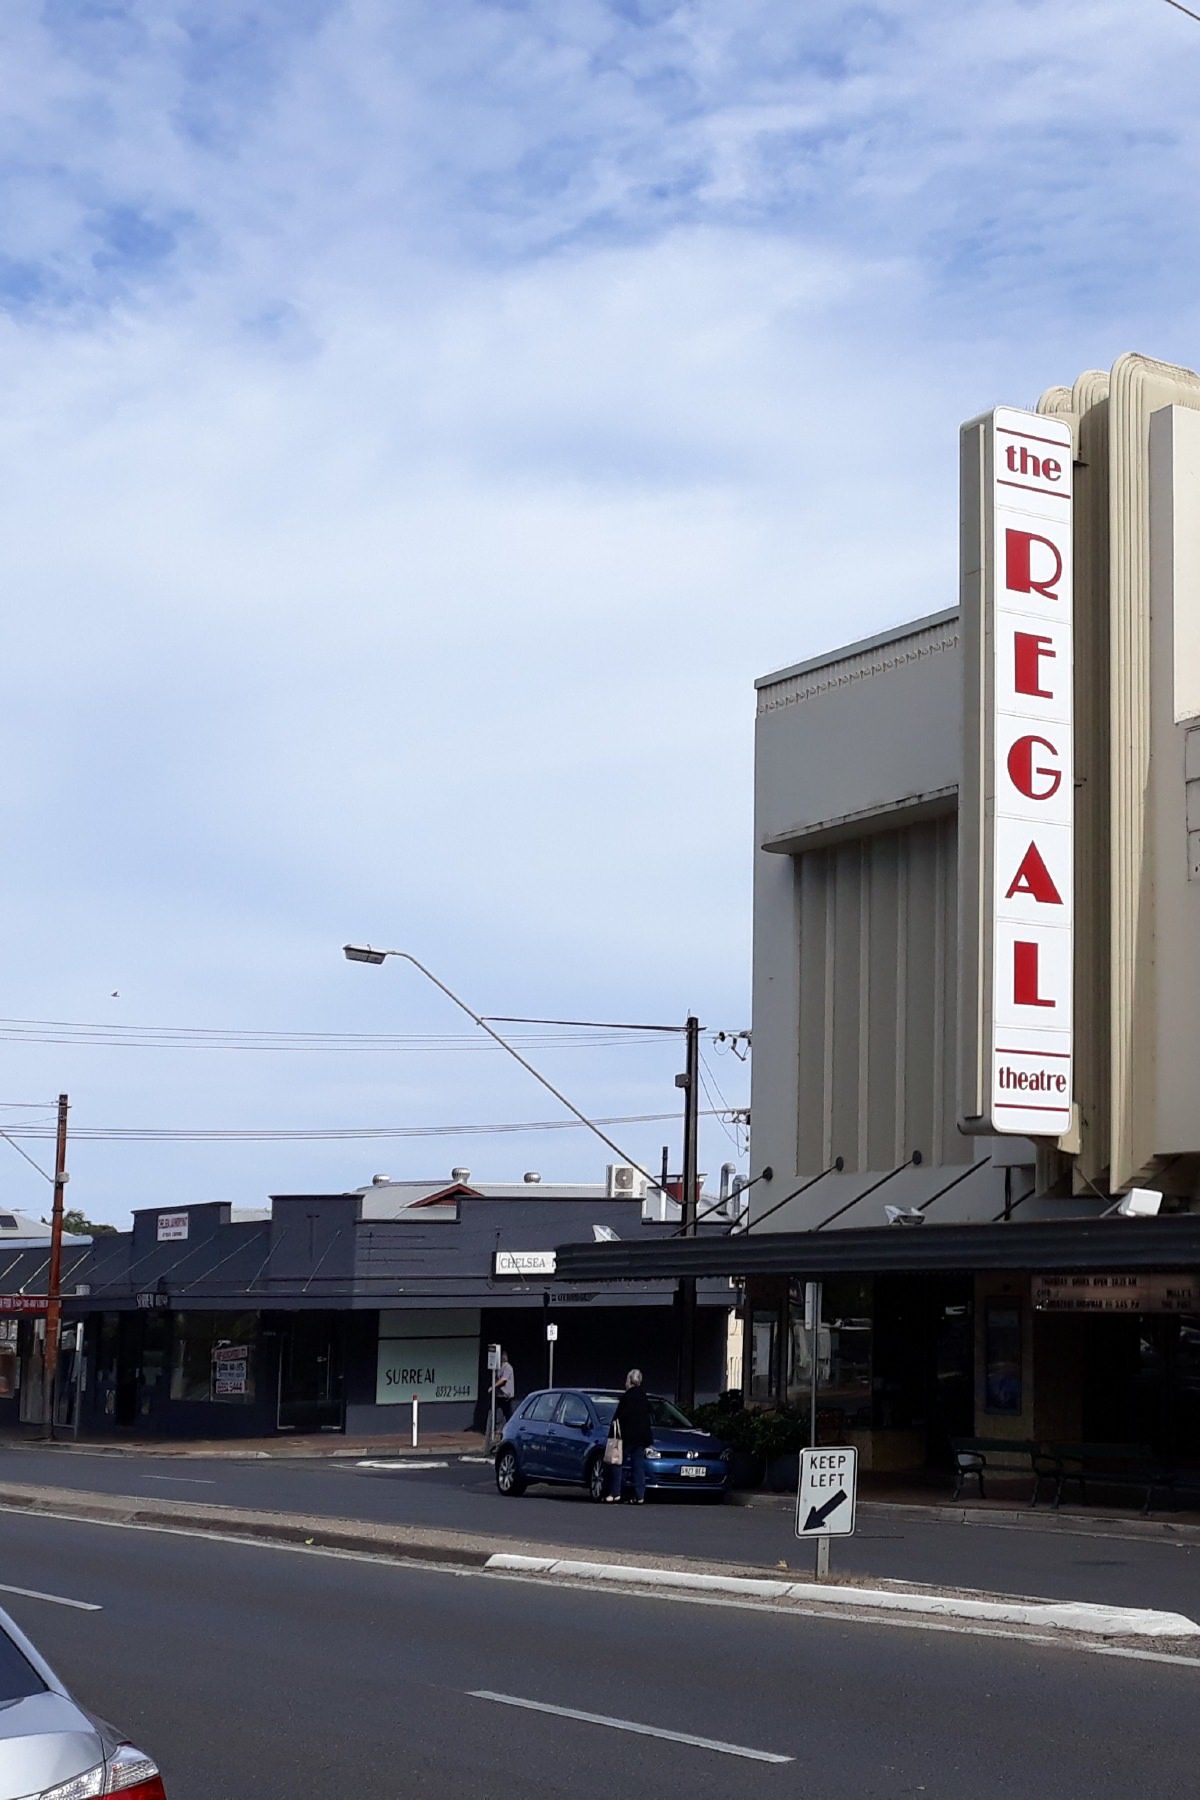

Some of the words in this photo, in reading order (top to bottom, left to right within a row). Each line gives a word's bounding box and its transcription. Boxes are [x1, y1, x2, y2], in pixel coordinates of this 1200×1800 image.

[1004, 444, 1062, 482] the
[1004, 527, 1064, 1008] REGAL
[998, 1066, 1067, 1093] theatre
[500, 1256, 546, 1269] CHELSEA
[810, 1454, 846, 1469] KEEP
[810, 1473, 844, 1487] LEFT
